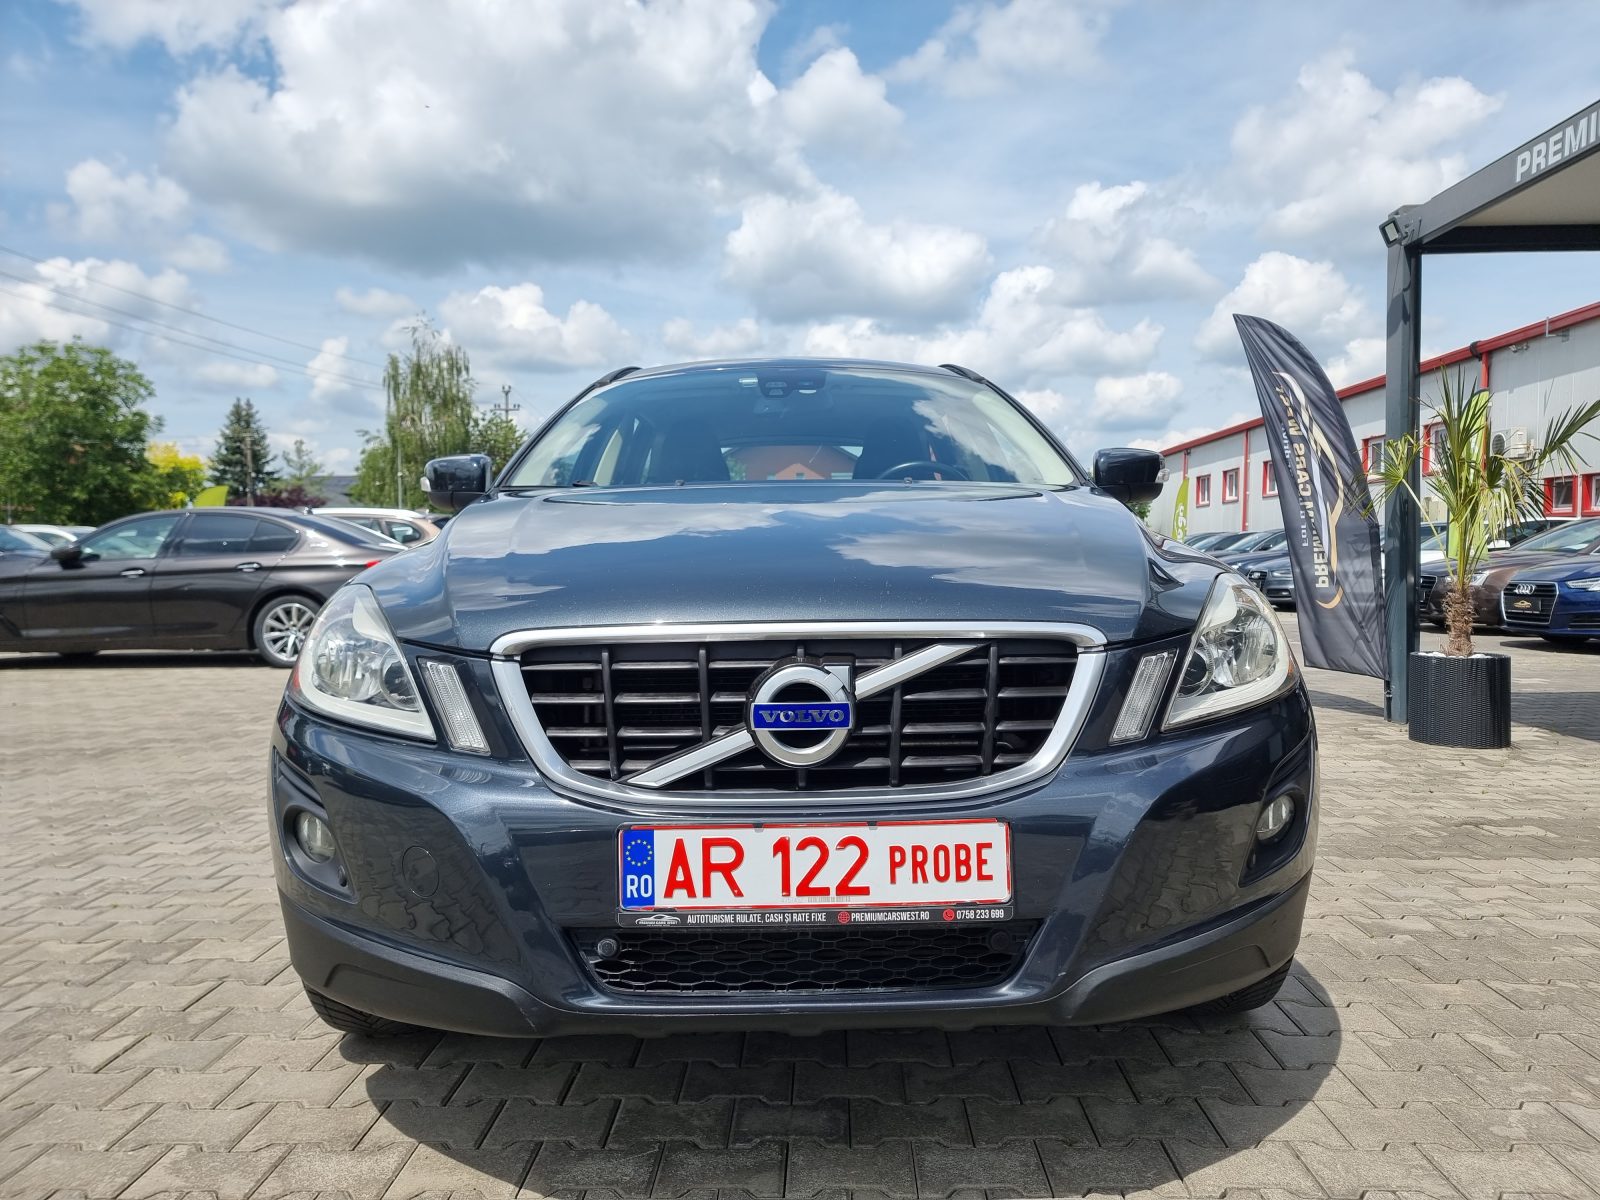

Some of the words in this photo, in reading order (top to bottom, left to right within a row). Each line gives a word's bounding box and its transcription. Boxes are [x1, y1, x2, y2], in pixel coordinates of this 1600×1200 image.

[1515, 110, 1600, 183] PREMI
[759, 709, 845, 723] VOLVO
[663, 837, 745, 899] AR
[772, 836, 871, 897] 122
[888, 842, 994, 885] PROBE
[626, 874, 653, 899] RO
[687, 914, 735, 924] AUTOTURISME
[736, 914, 764, 924] RULATE,
[765, 913, 783, 923] CASH
[793, 912, 810, 922] RATE
[811, 912, 827, 922] FIXE
[851, 911, 930, 922] PREMIUMCARSWEST.RO
[956, 909, 974, 920] 0758
[975, 908, 990, 919] 233
[991, 908, 1004, 919] 699
